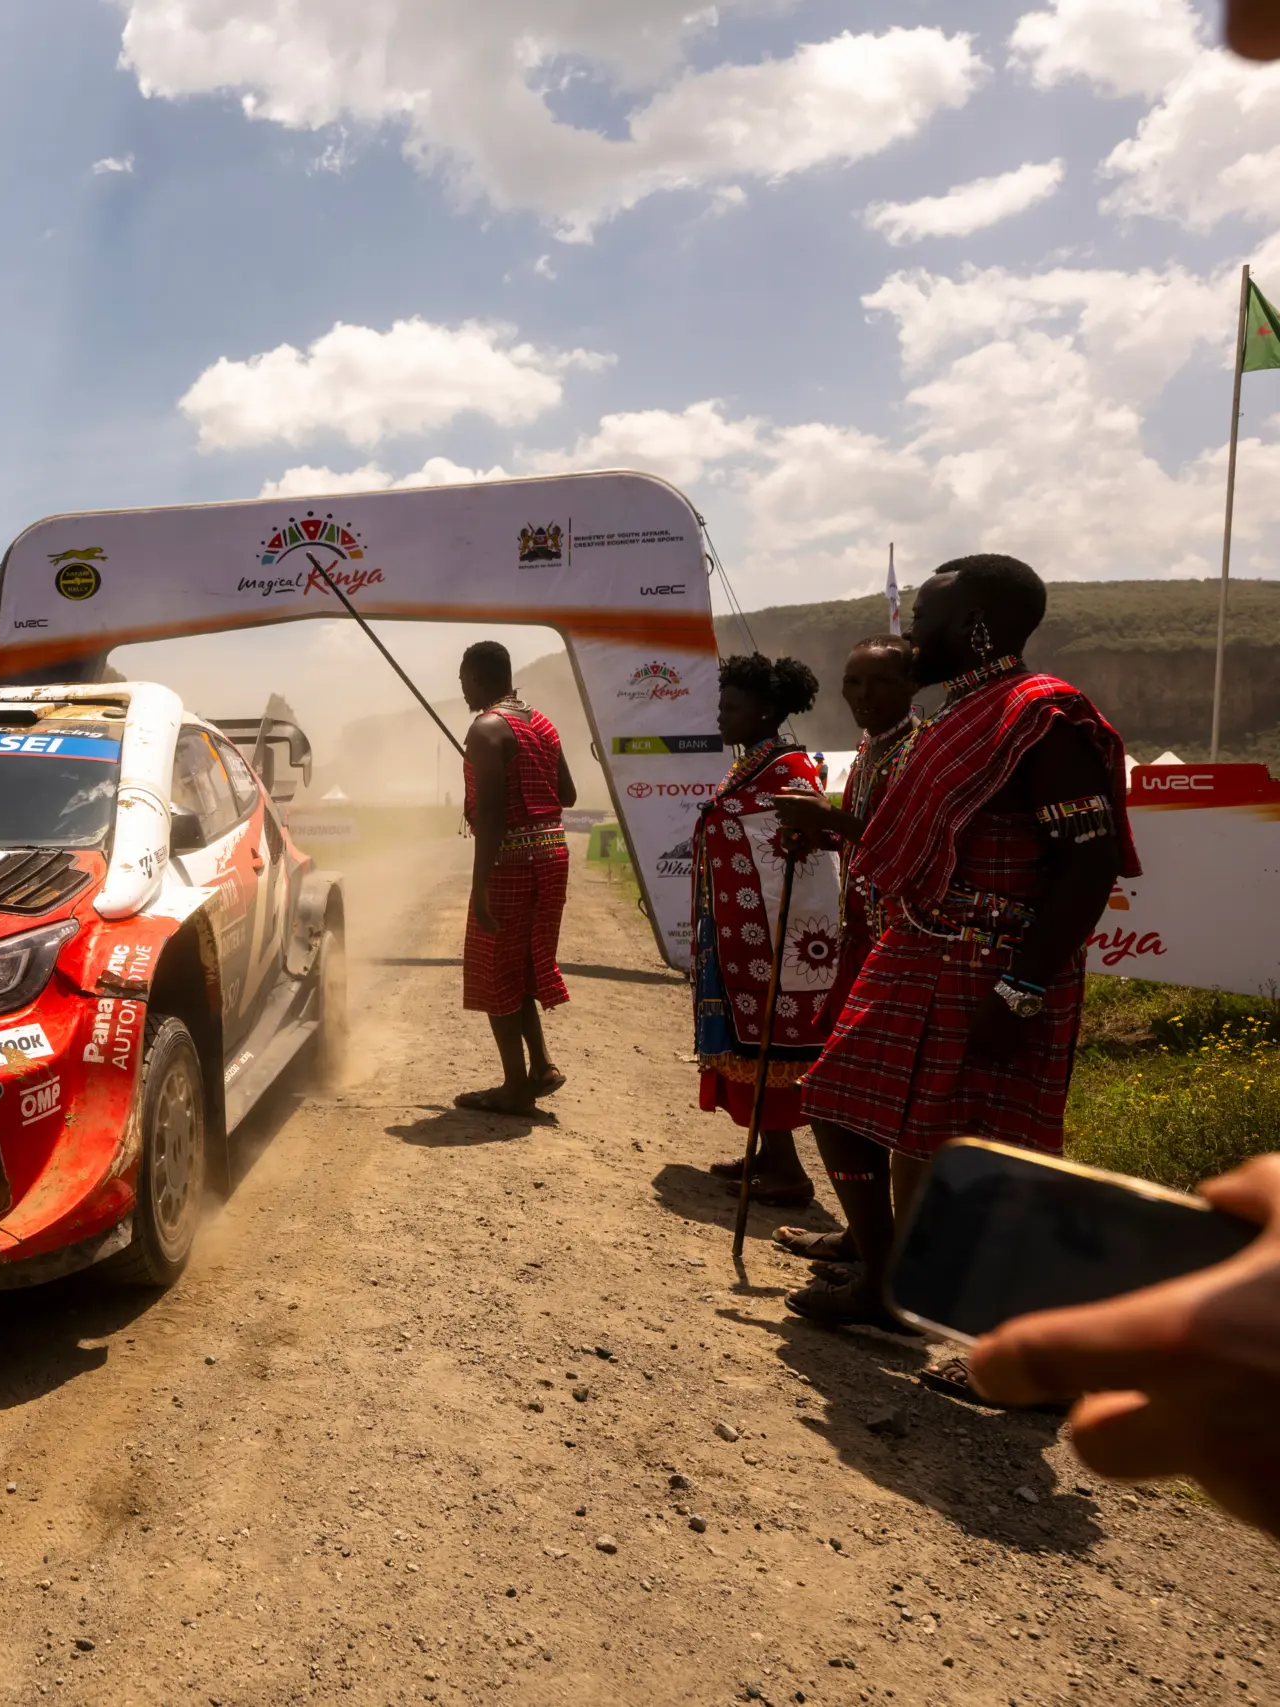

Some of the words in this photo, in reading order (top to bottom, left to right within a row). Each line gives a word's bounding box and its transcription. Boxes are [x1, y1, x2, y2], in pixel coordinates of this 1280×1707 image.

[237, 572, 305, 596] Magical
[640, 584, 686, 595] WRC
[14, 619, 48, 629] WRC
[650, 684, 691, 700] Kenya
[678, 740, 708, 749] BANK
[655, 784, 717, 796] TOYOT
[1142, 774, 1214, 790] WRC
[1085, 927, 1168, 967] nya
[82, 944, 131, 1065] Pananic
[20, 1082, 62, 1119] OMP
